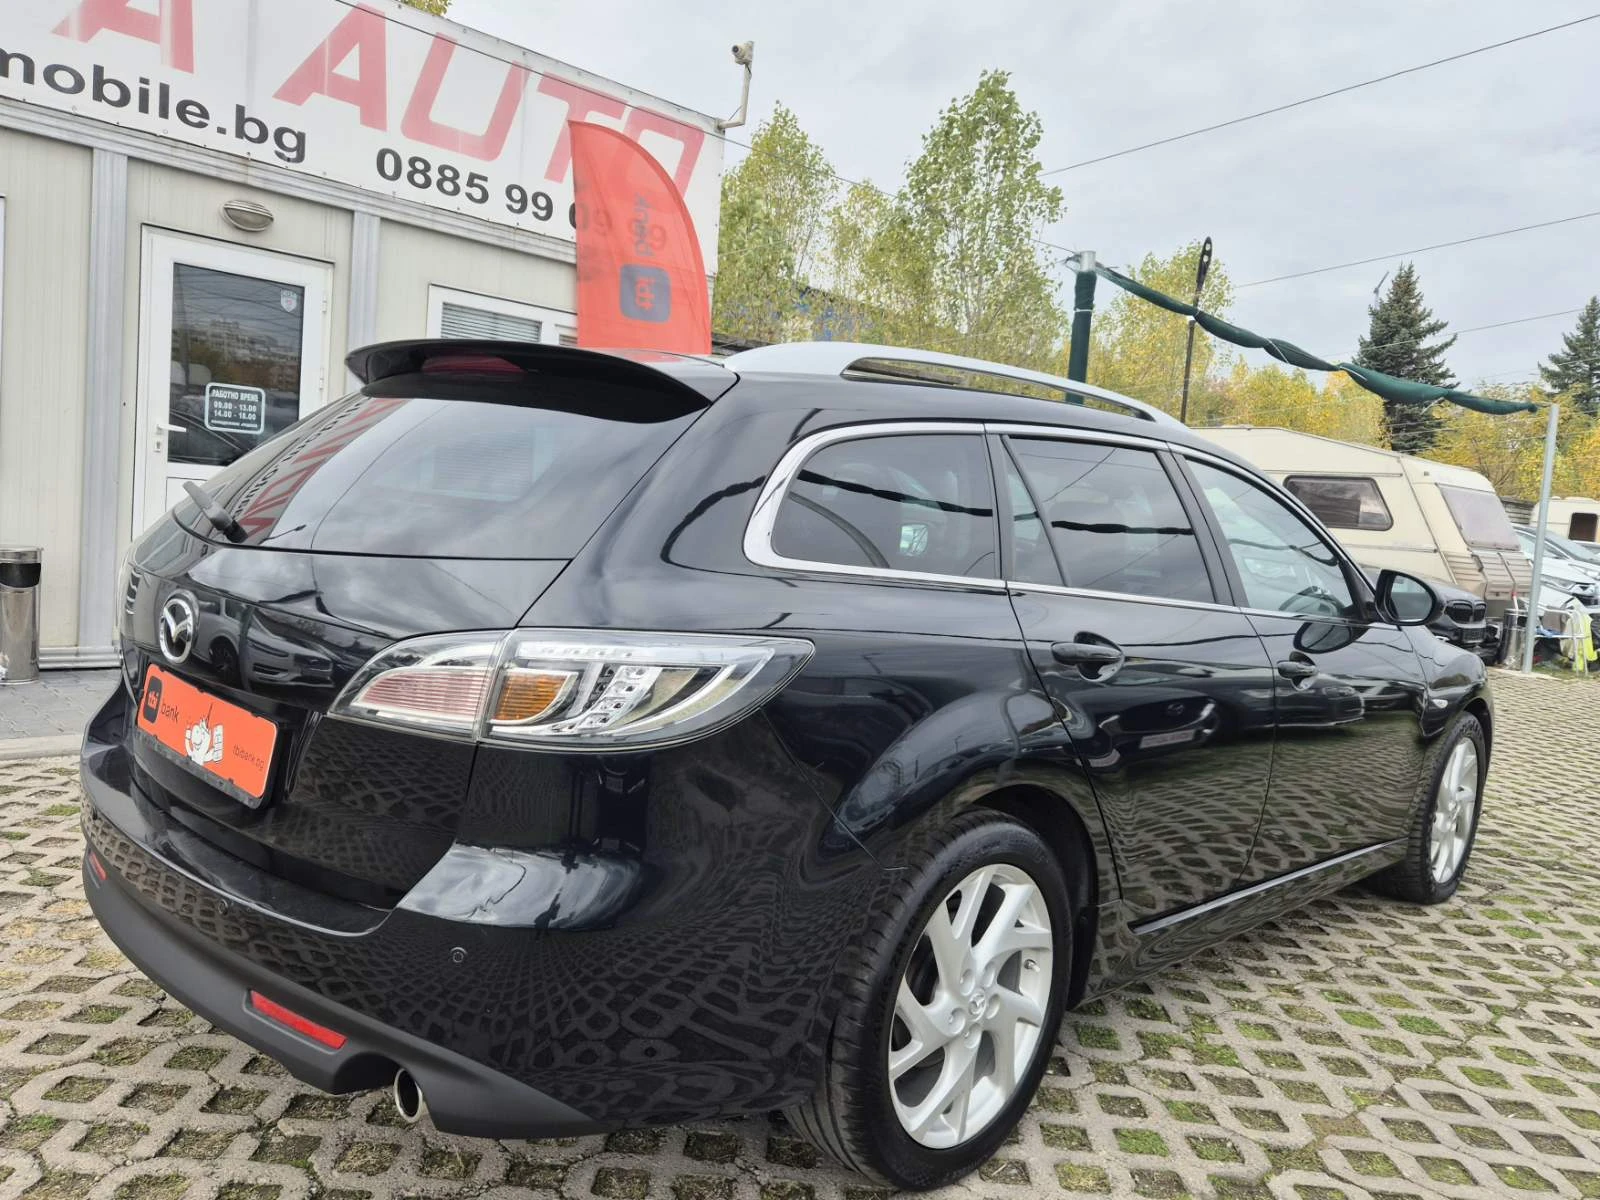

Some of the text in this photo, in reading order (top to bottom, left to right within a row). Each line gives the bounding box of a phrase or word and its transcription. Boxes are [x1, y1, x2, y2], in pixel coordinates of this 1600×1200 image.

[272, 2, 706, 213] AUTO
[376, 148, 489, 204] 0885
[505, 183, 554, 222] 99
[211, 388, 239, 400] РАБОТНО
[213, 409, 233, 418] 14.00
[239, 404, 257, 412] 13.00
